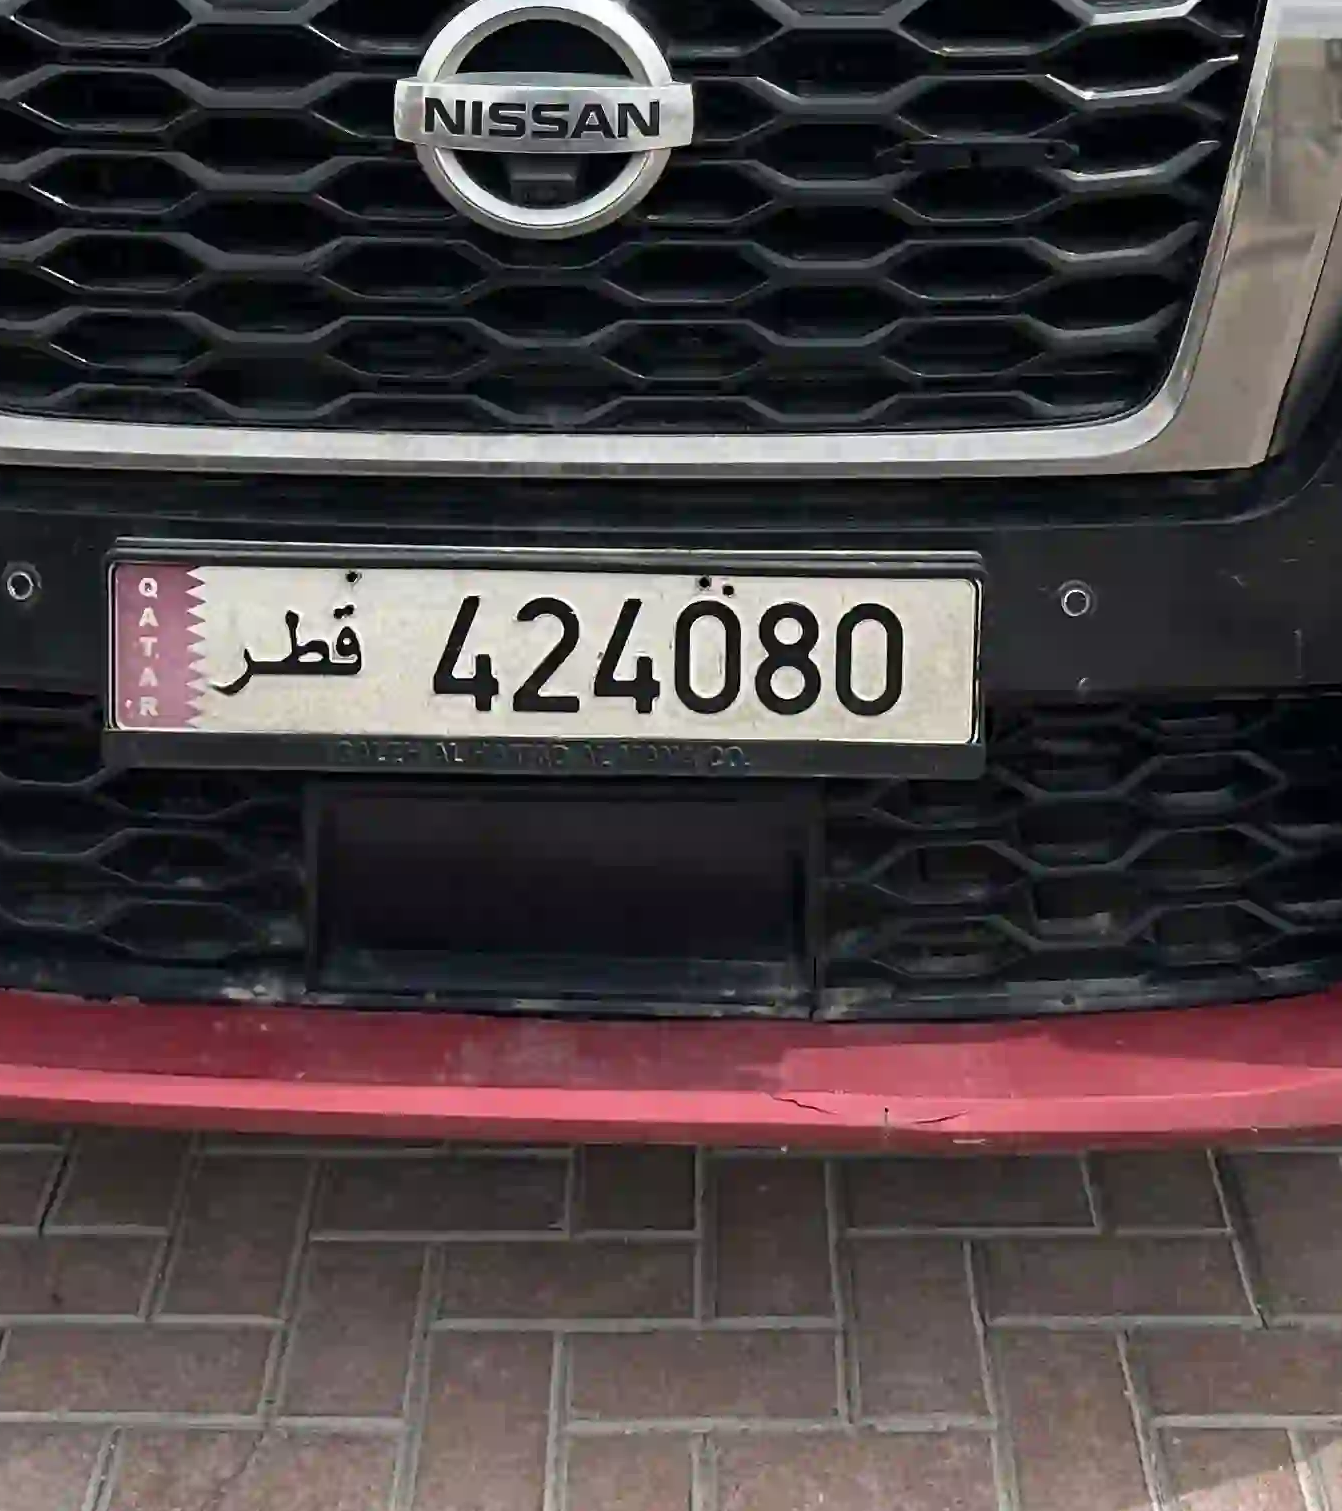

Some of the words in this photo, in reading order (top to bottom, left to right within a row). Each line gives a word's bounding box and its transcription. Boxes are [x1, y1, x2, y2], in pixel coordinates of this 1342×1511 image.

[424, 97, 660, 141] NISSAN
[138, 577, 159, 717] QATAR
[211, 604, 362, 697] قطر
[432, 595, 904, 717] 424080
